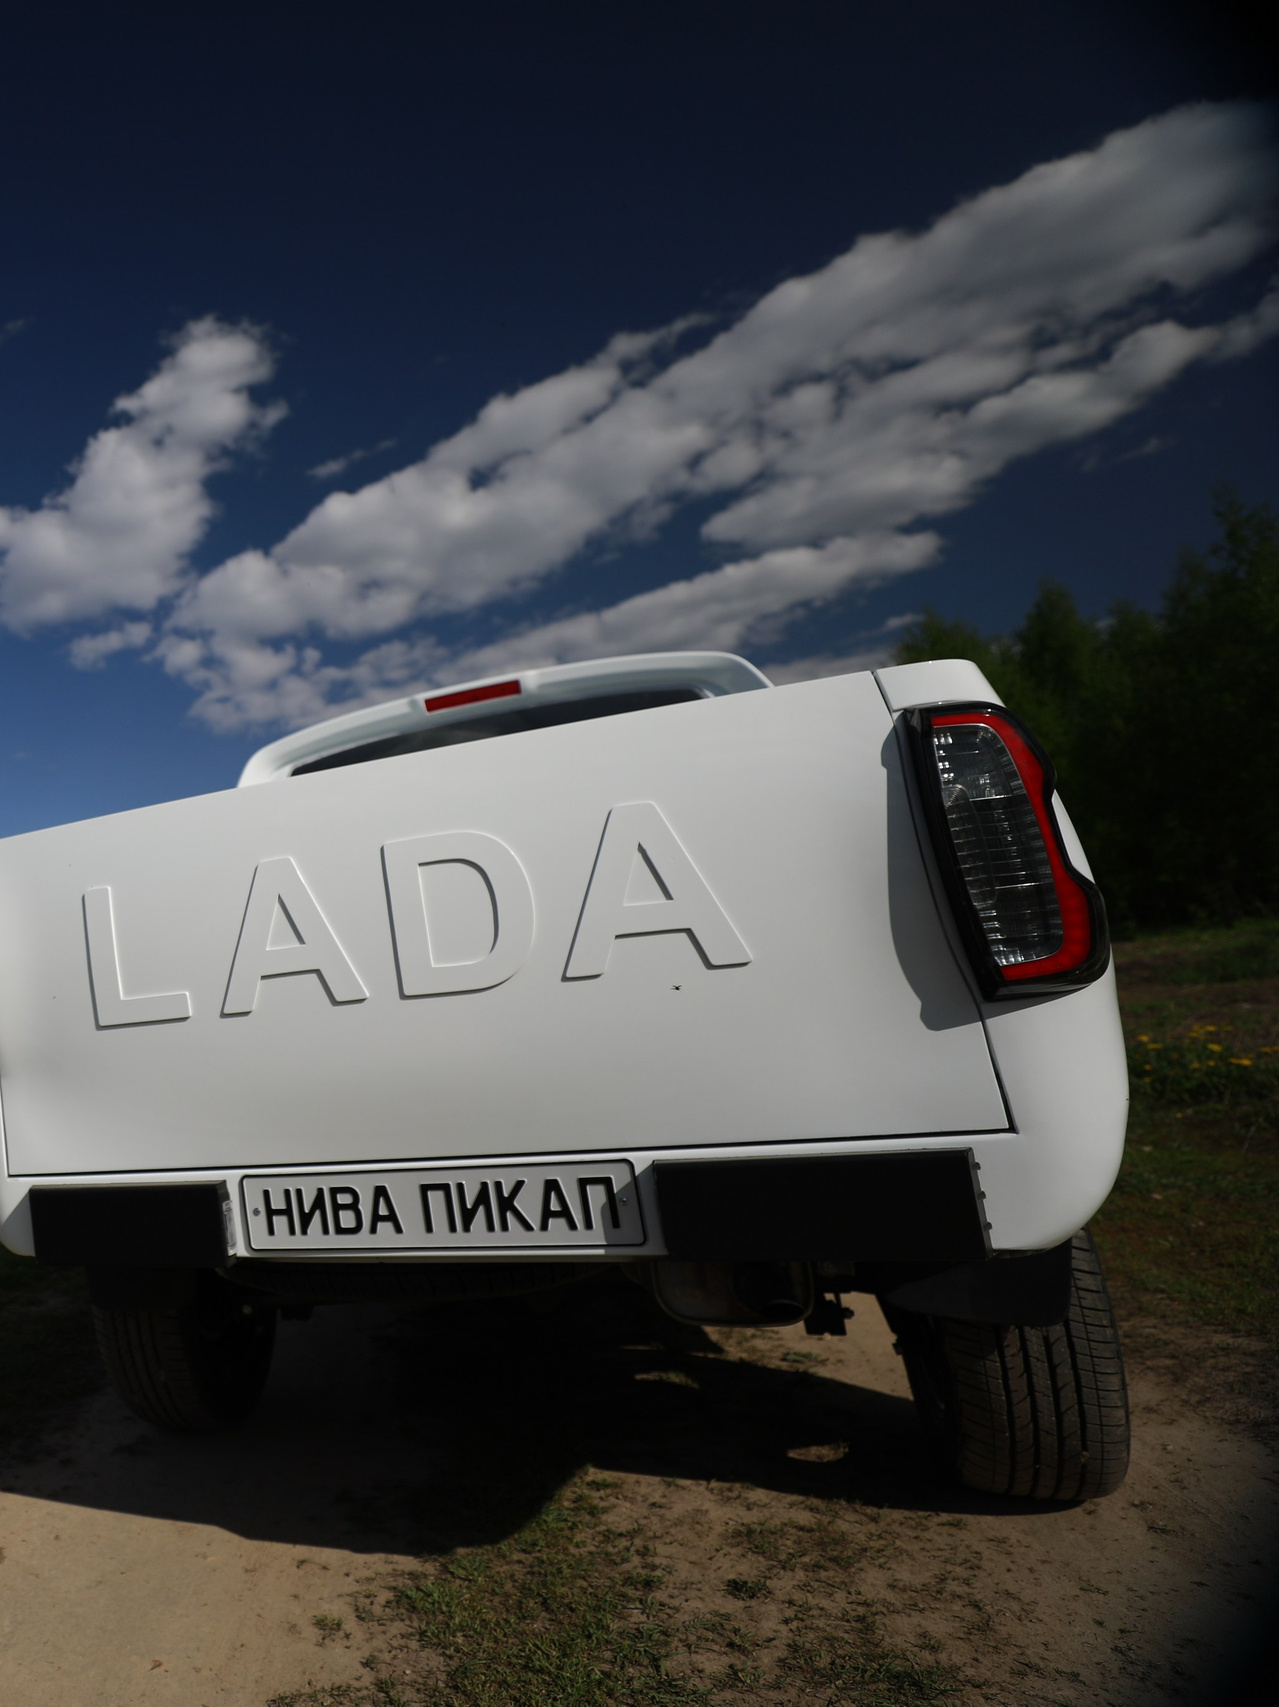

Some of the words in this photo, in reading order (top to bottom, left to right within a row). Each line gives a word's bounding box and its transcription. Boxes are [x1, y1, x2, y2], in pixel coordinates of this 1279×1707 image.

[82, 799, 754, 1029] LADA
[262, 1184, 405, 1238] НИВА
[419, 1175, 622, 1235] ПИКАП
